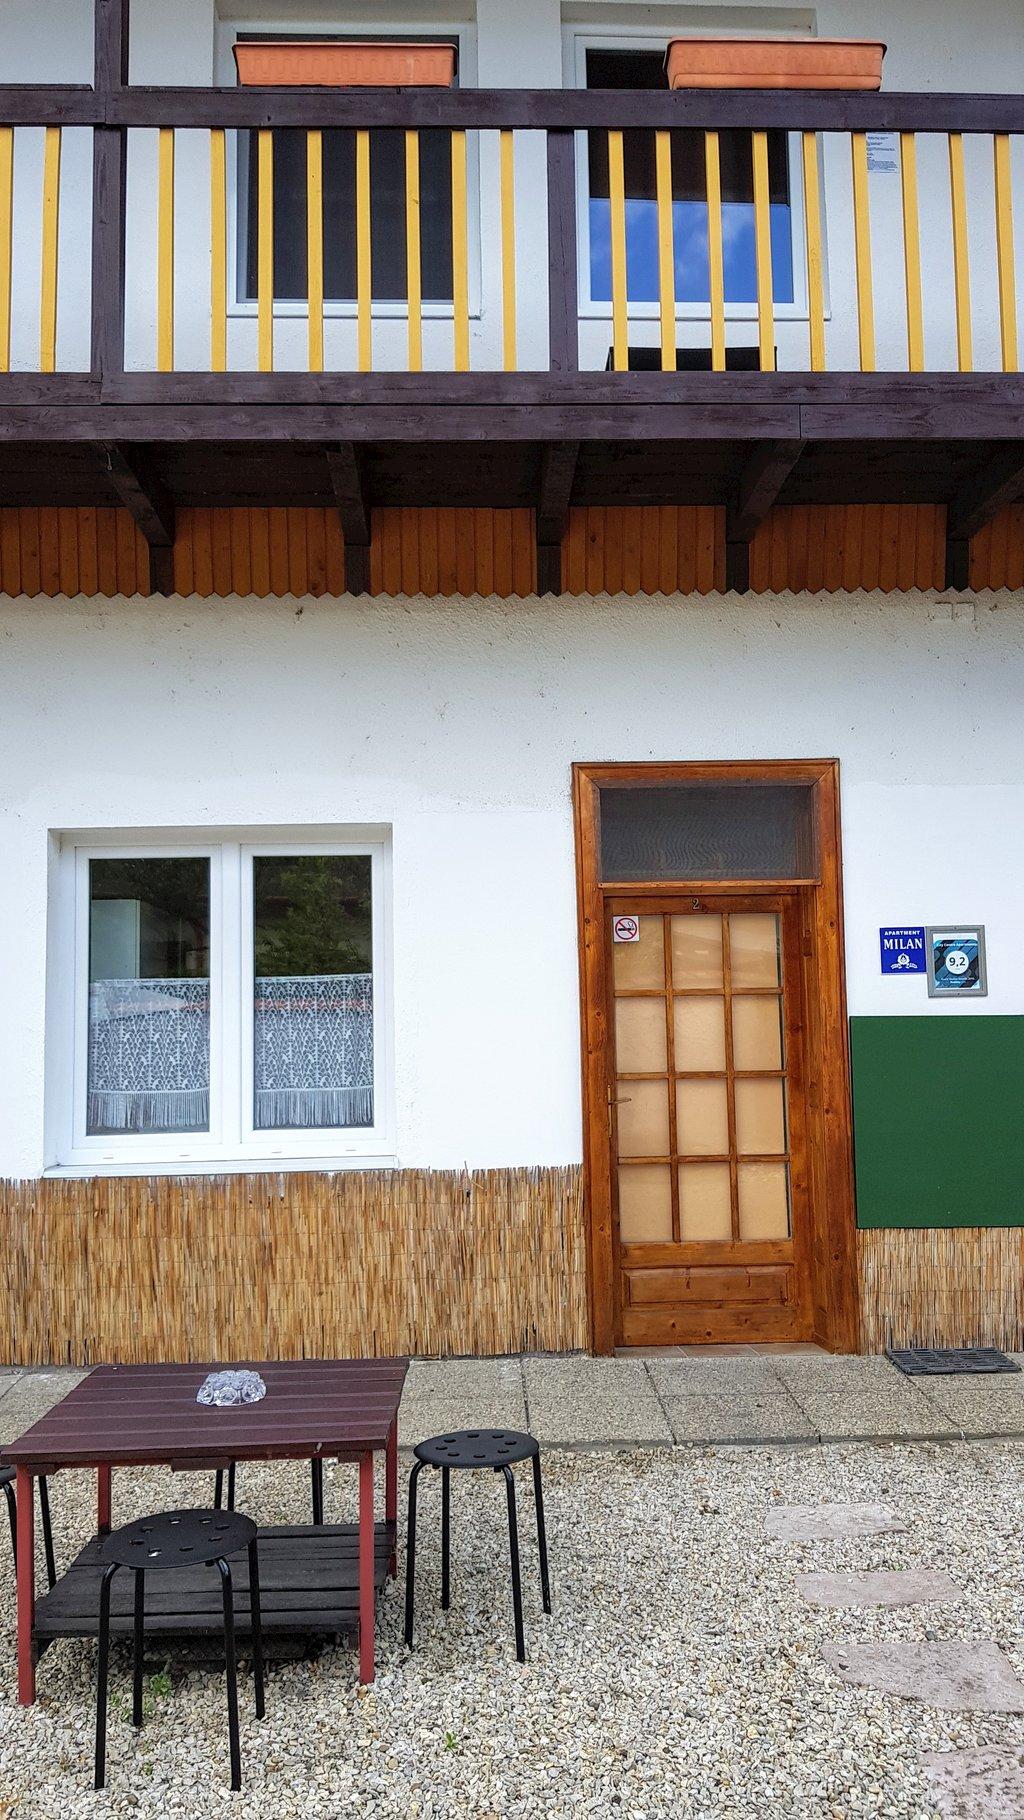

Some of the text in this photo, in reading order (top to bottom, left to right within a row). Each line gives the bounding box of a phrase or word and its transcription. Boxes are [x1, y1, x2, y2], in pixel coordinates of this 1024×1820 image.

[692, 898, 700, 910] 2
[883, 938, 923, 950] MILAN
[949, 957, 966, 967] 9,2
